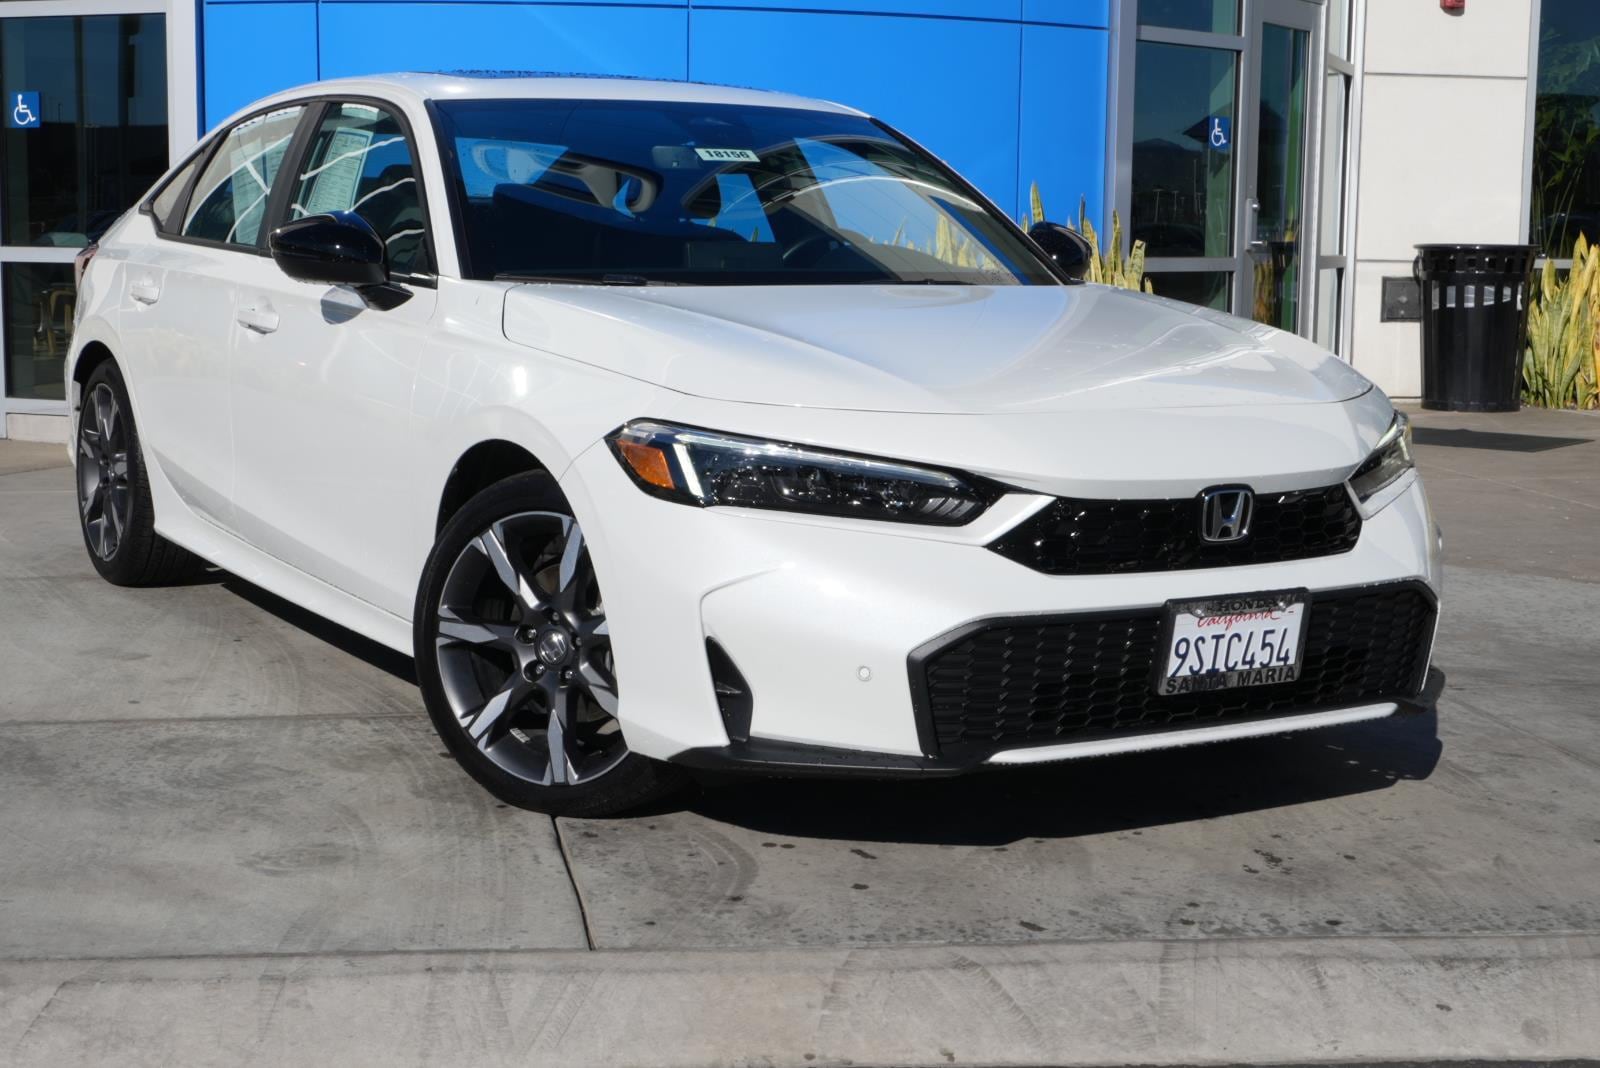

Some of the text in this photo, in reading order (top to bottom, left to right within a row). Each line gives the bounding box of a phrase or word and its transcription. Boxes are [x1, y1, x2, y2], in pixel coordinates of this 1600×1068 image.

[705, 149, 750, 159] 18156
[1217, 597, 1279, 612] HONDA
[1165, 665, 1296, 694] SANTA MARIA
